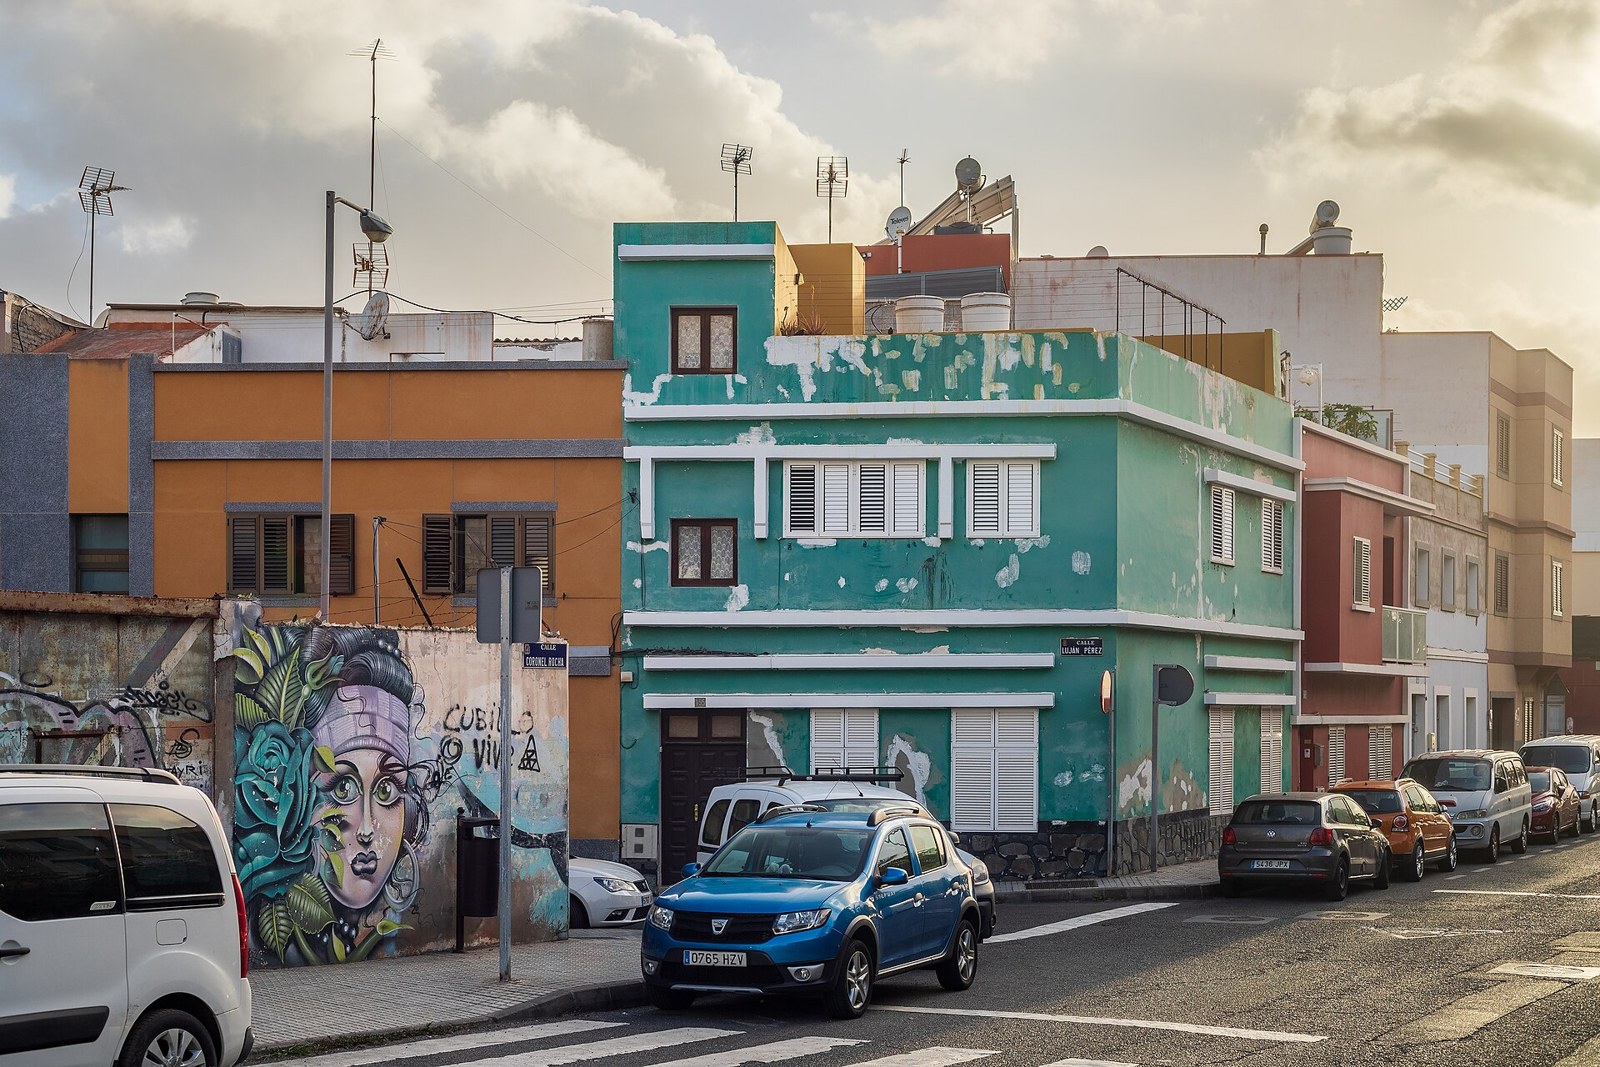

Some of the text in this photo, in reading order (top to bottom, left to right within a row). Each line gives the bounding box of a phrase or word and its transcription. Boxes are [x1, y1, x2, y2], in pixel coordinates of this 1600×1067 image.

[1061, 646, 1103, 654] LUJÁN PÉREZ
[525, 656, 565, 667] CORONEL ROCHA
[1275, 860, 1288, 868] JPX
[691, 952, 719, 965] 0765
[722, 953, 744, 965] HZV
